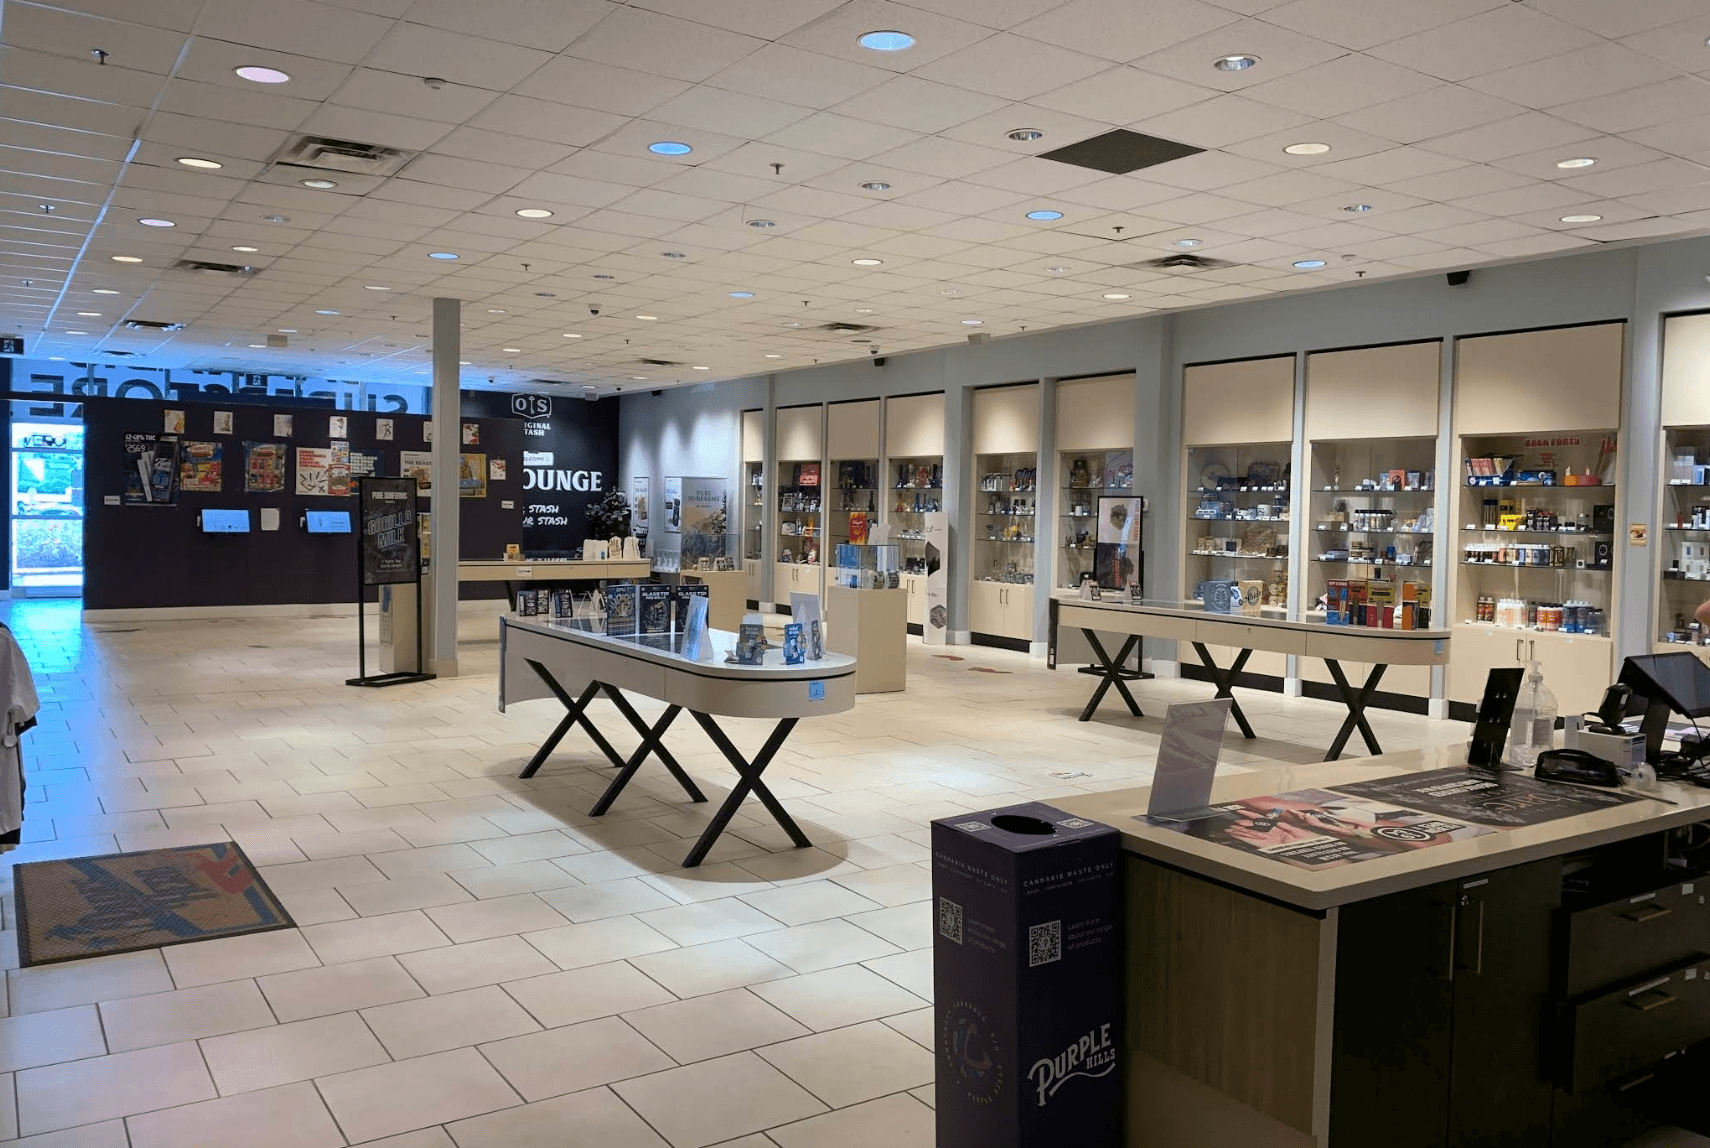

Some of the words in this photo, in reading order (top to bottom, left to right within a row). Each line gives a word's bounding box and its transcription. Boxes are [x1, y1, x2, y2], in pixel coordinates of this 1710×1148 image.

[528, 504, 559, 514] STASH
[368, 509, 412, 535] GORILLA
[537, 517, 568, 526] STASH
[377, 527, 405, 548] MILK
[936, 851, 965, 868] CANNABIS
[967, 864, 988, 878] WASTE
[990, 874, 1008, 885] ONLY
[1023, 873, 1064, 887] CANNABIS
[1066, 866, 1092, 877] WASTE
[1094, 862, 1114, 871] ONLY
[1067, 921, 1085, 931] Learn
[1085, 918, 1100, 926] more
[1067, 931, 1085, 941] about
[1085, 928, 1095, 936] our
[1096, 925, 1112, 934] range
[1075, 937, 1102, 949] products
[1027, 1022, 1111, 1106] PURPLE
[1086, 1047, 1116, 1070] HILLS
